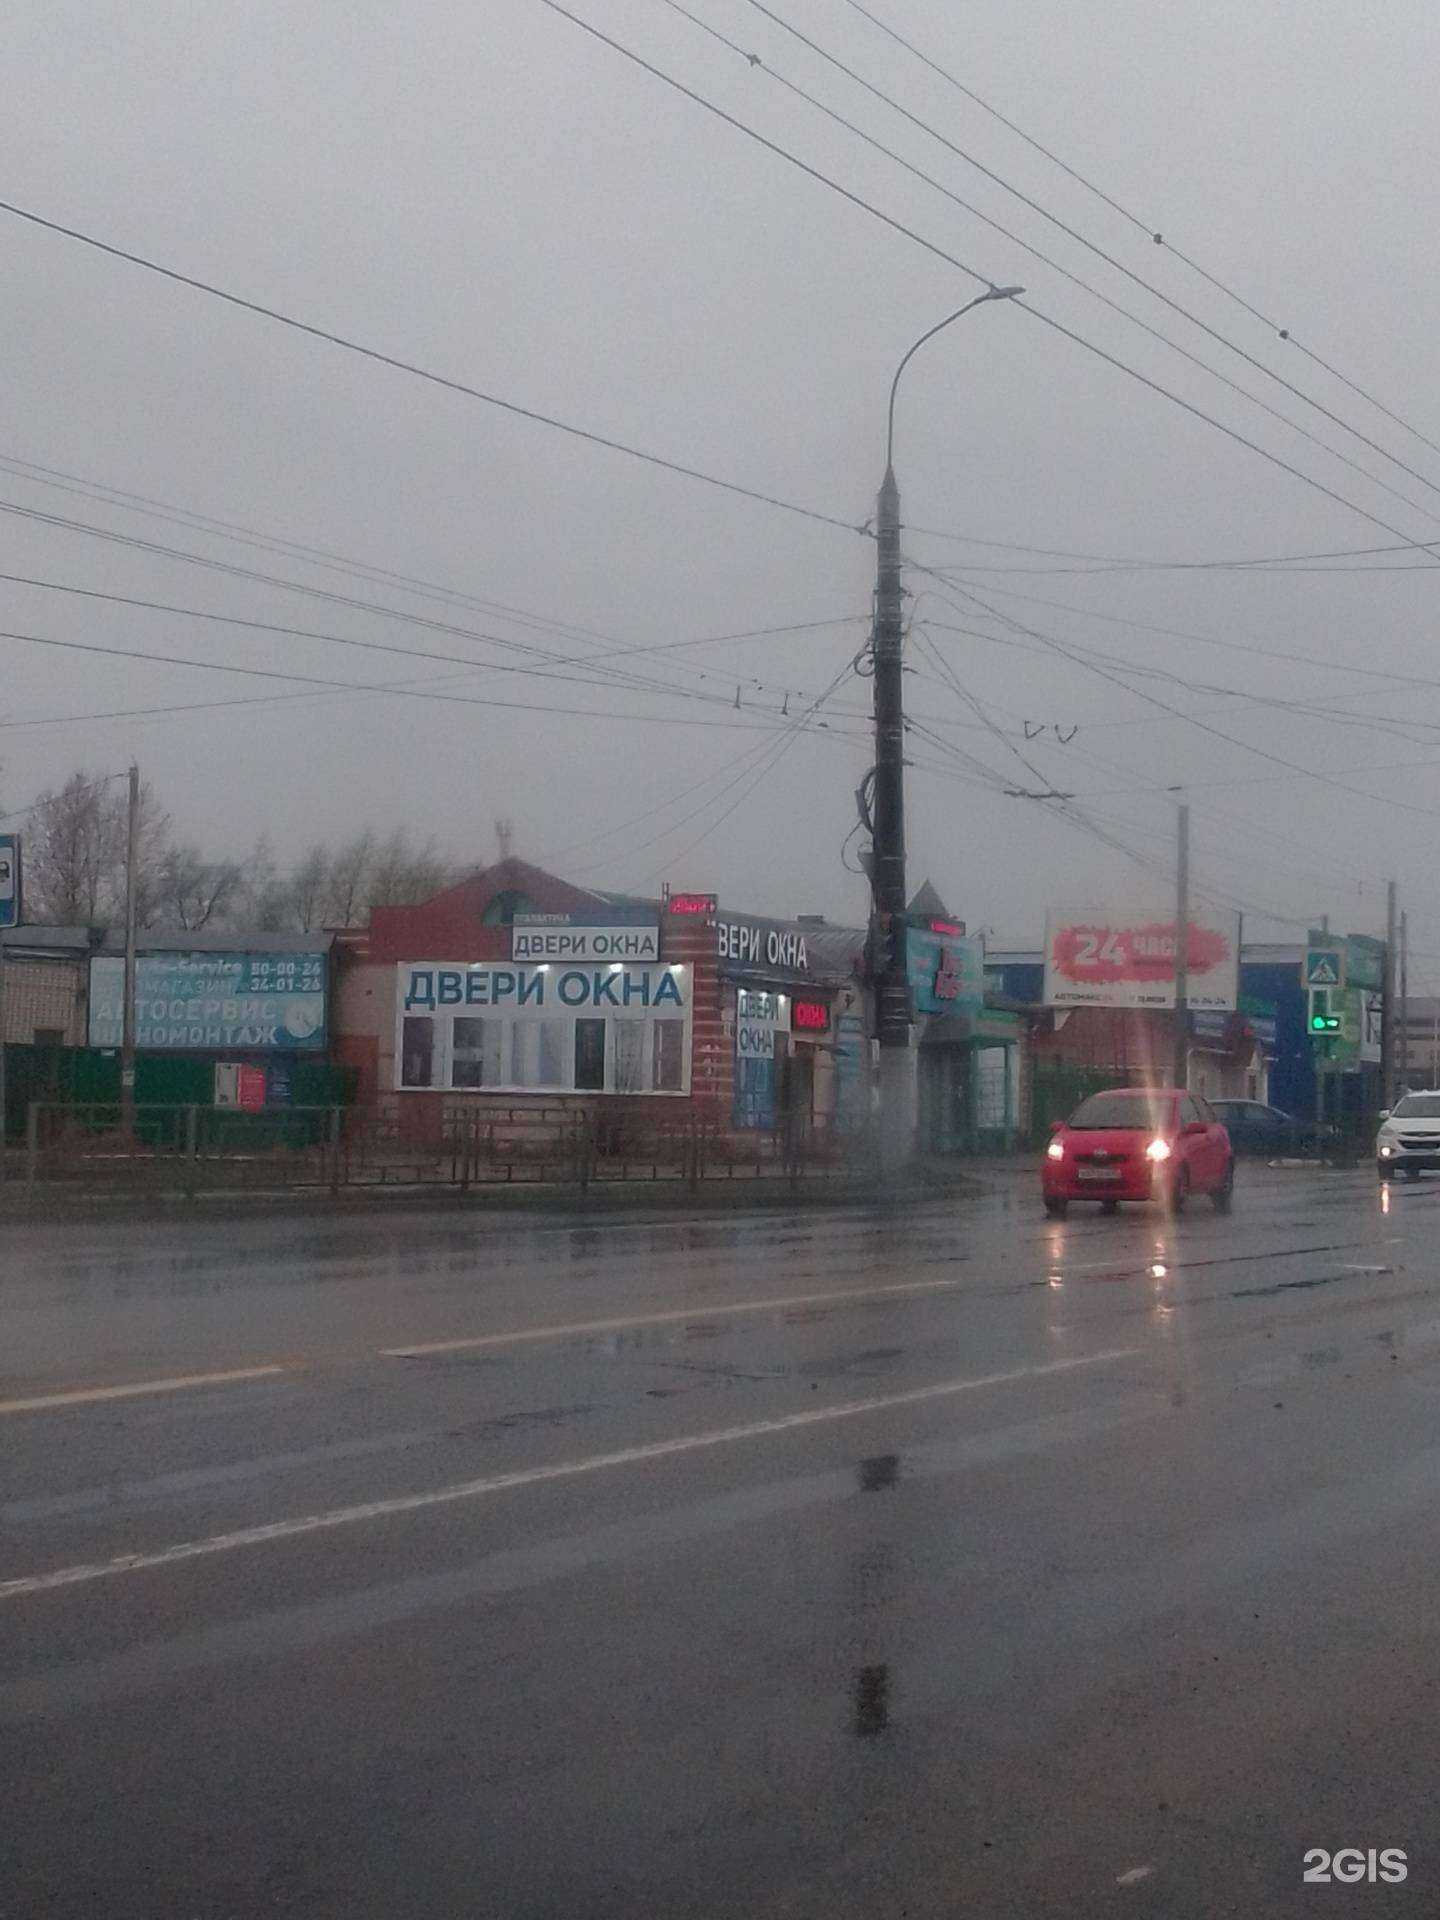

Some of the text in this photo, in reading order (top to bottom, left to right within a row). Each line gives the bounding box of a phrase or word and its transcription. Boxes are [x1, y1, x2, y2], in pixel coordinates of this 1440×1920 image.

[515, 935, 655, 957] ДВЕРИ ОКНА
[718, 923, 808, 969] ВЕРИ ОКНА
[1075, 933, 1126, 966] 24
[404, 971, 684, 1011] ДВЕРИ ОКНА
[739, 1027, 772, 1053] ОКНА
